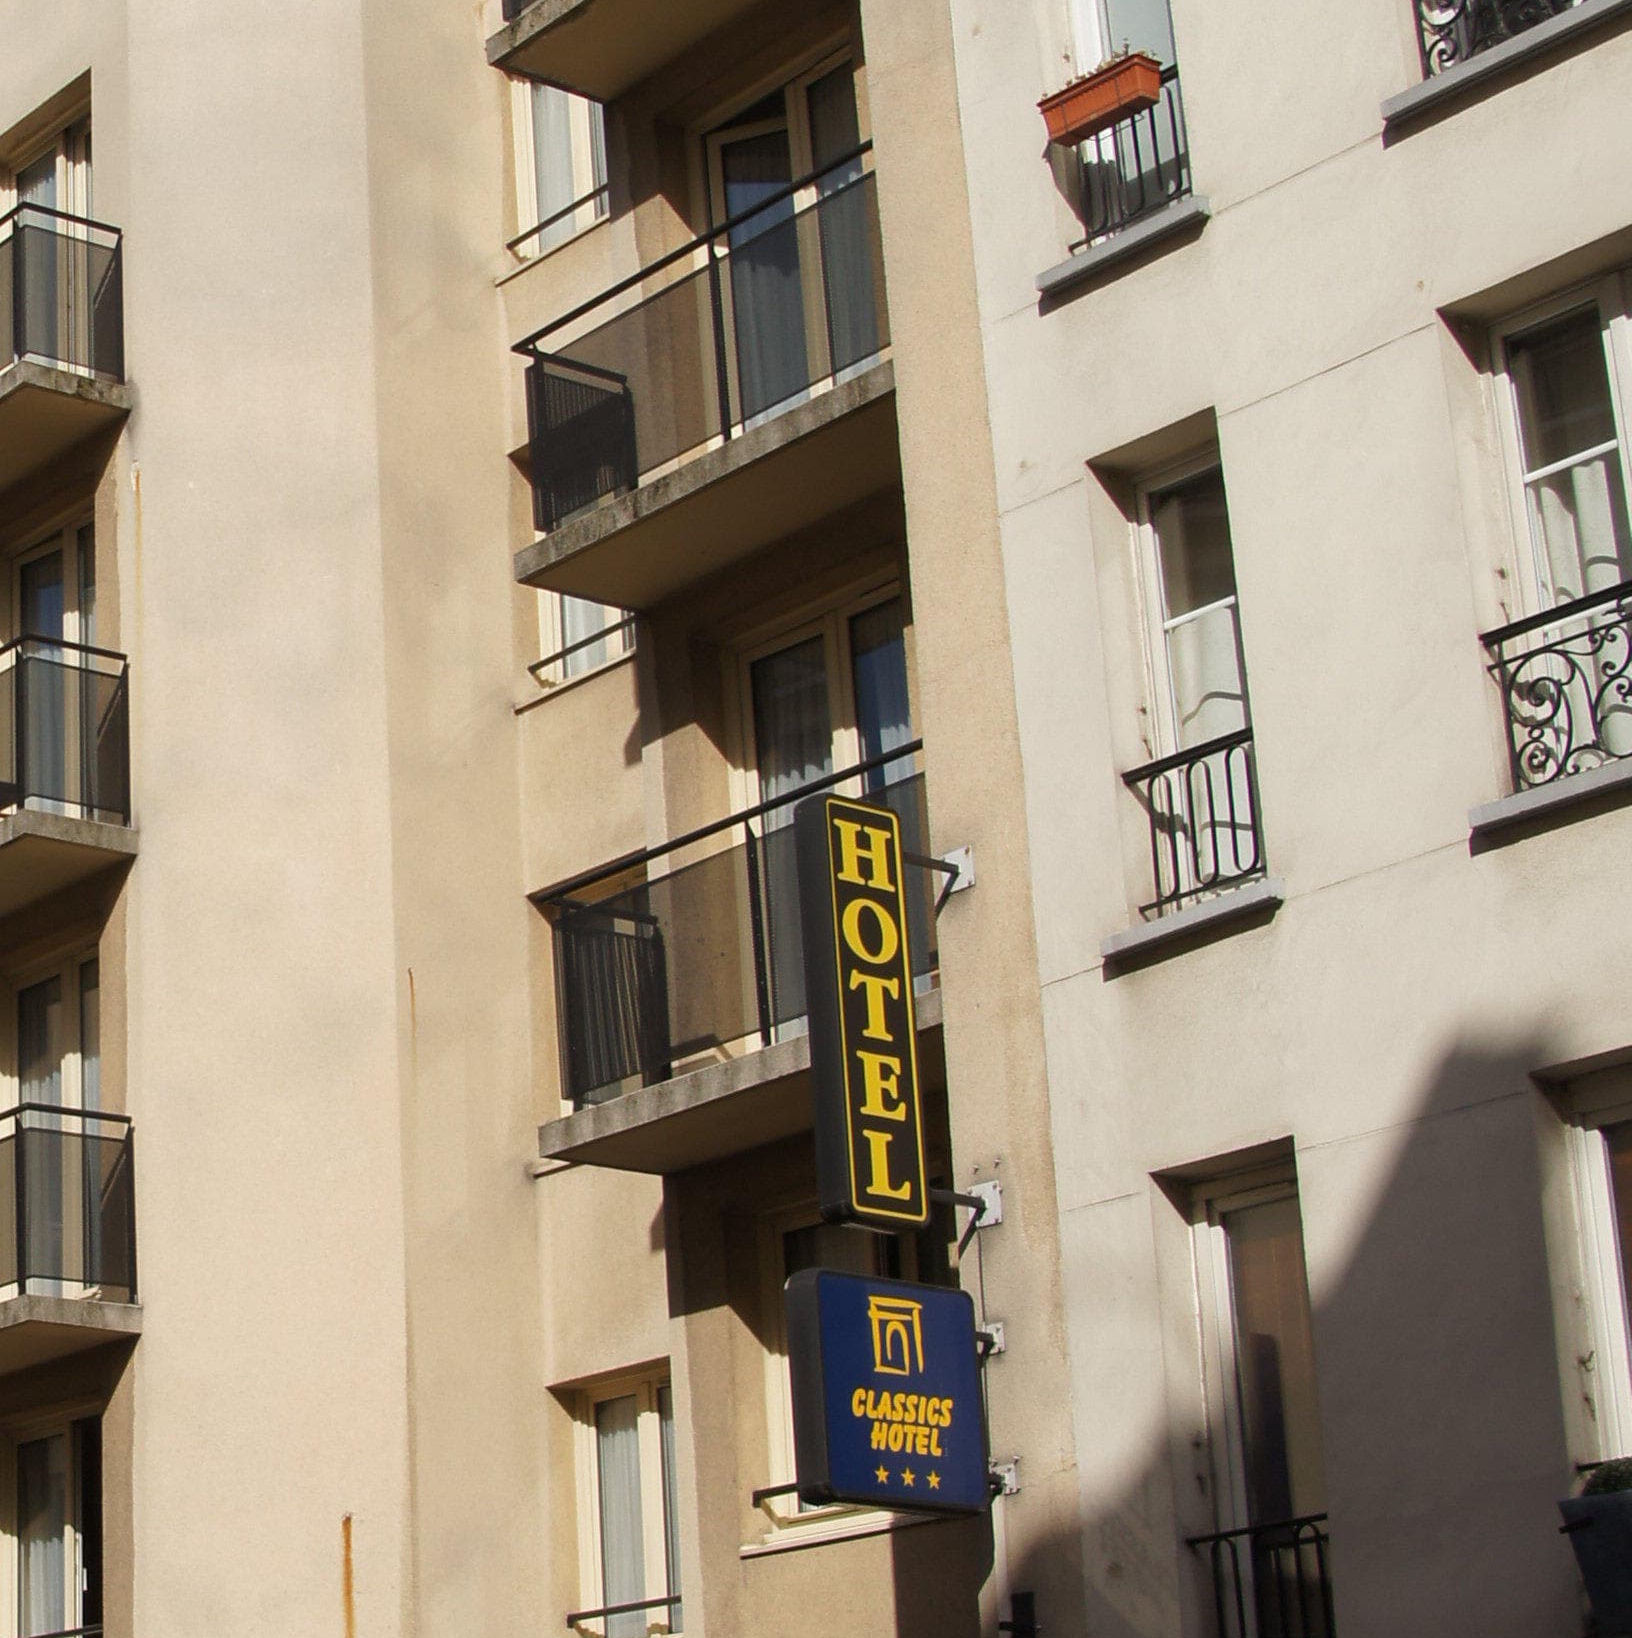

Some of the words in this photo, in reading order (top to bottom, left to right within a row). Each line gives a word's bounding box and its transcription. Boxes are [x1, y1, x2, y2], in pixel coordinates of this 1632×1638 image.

[833, 817, 912, 1202] HOTEL
[851, 1387, 954, 1428] CLASSICS
[870, 1421, 943, 1457] HOTEL
